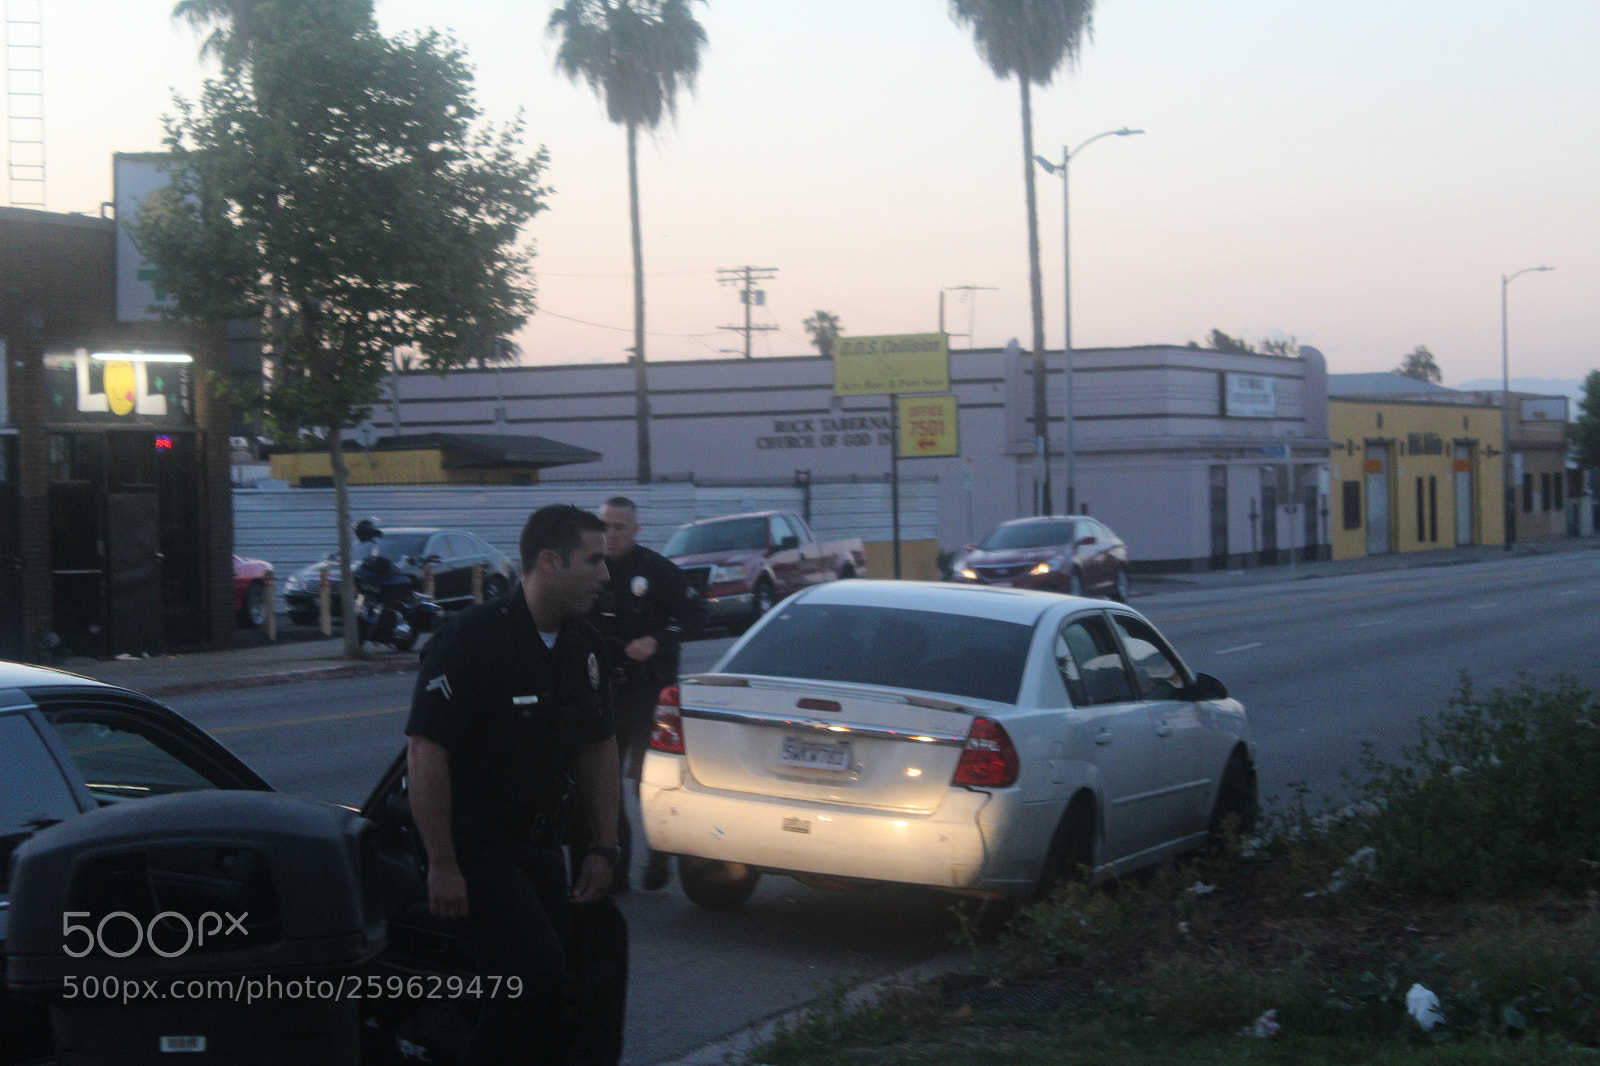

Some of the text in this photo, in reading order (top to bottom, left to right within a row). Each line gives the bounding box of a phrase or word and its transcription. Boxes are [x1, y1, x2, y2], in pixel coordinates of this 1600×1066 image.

[773, 419, 814, 433] ROCK
[756, 434, 815, 450] CHURCH
[820, 433, 837, 448] OF
[842, 432, 872, 447] GOD
